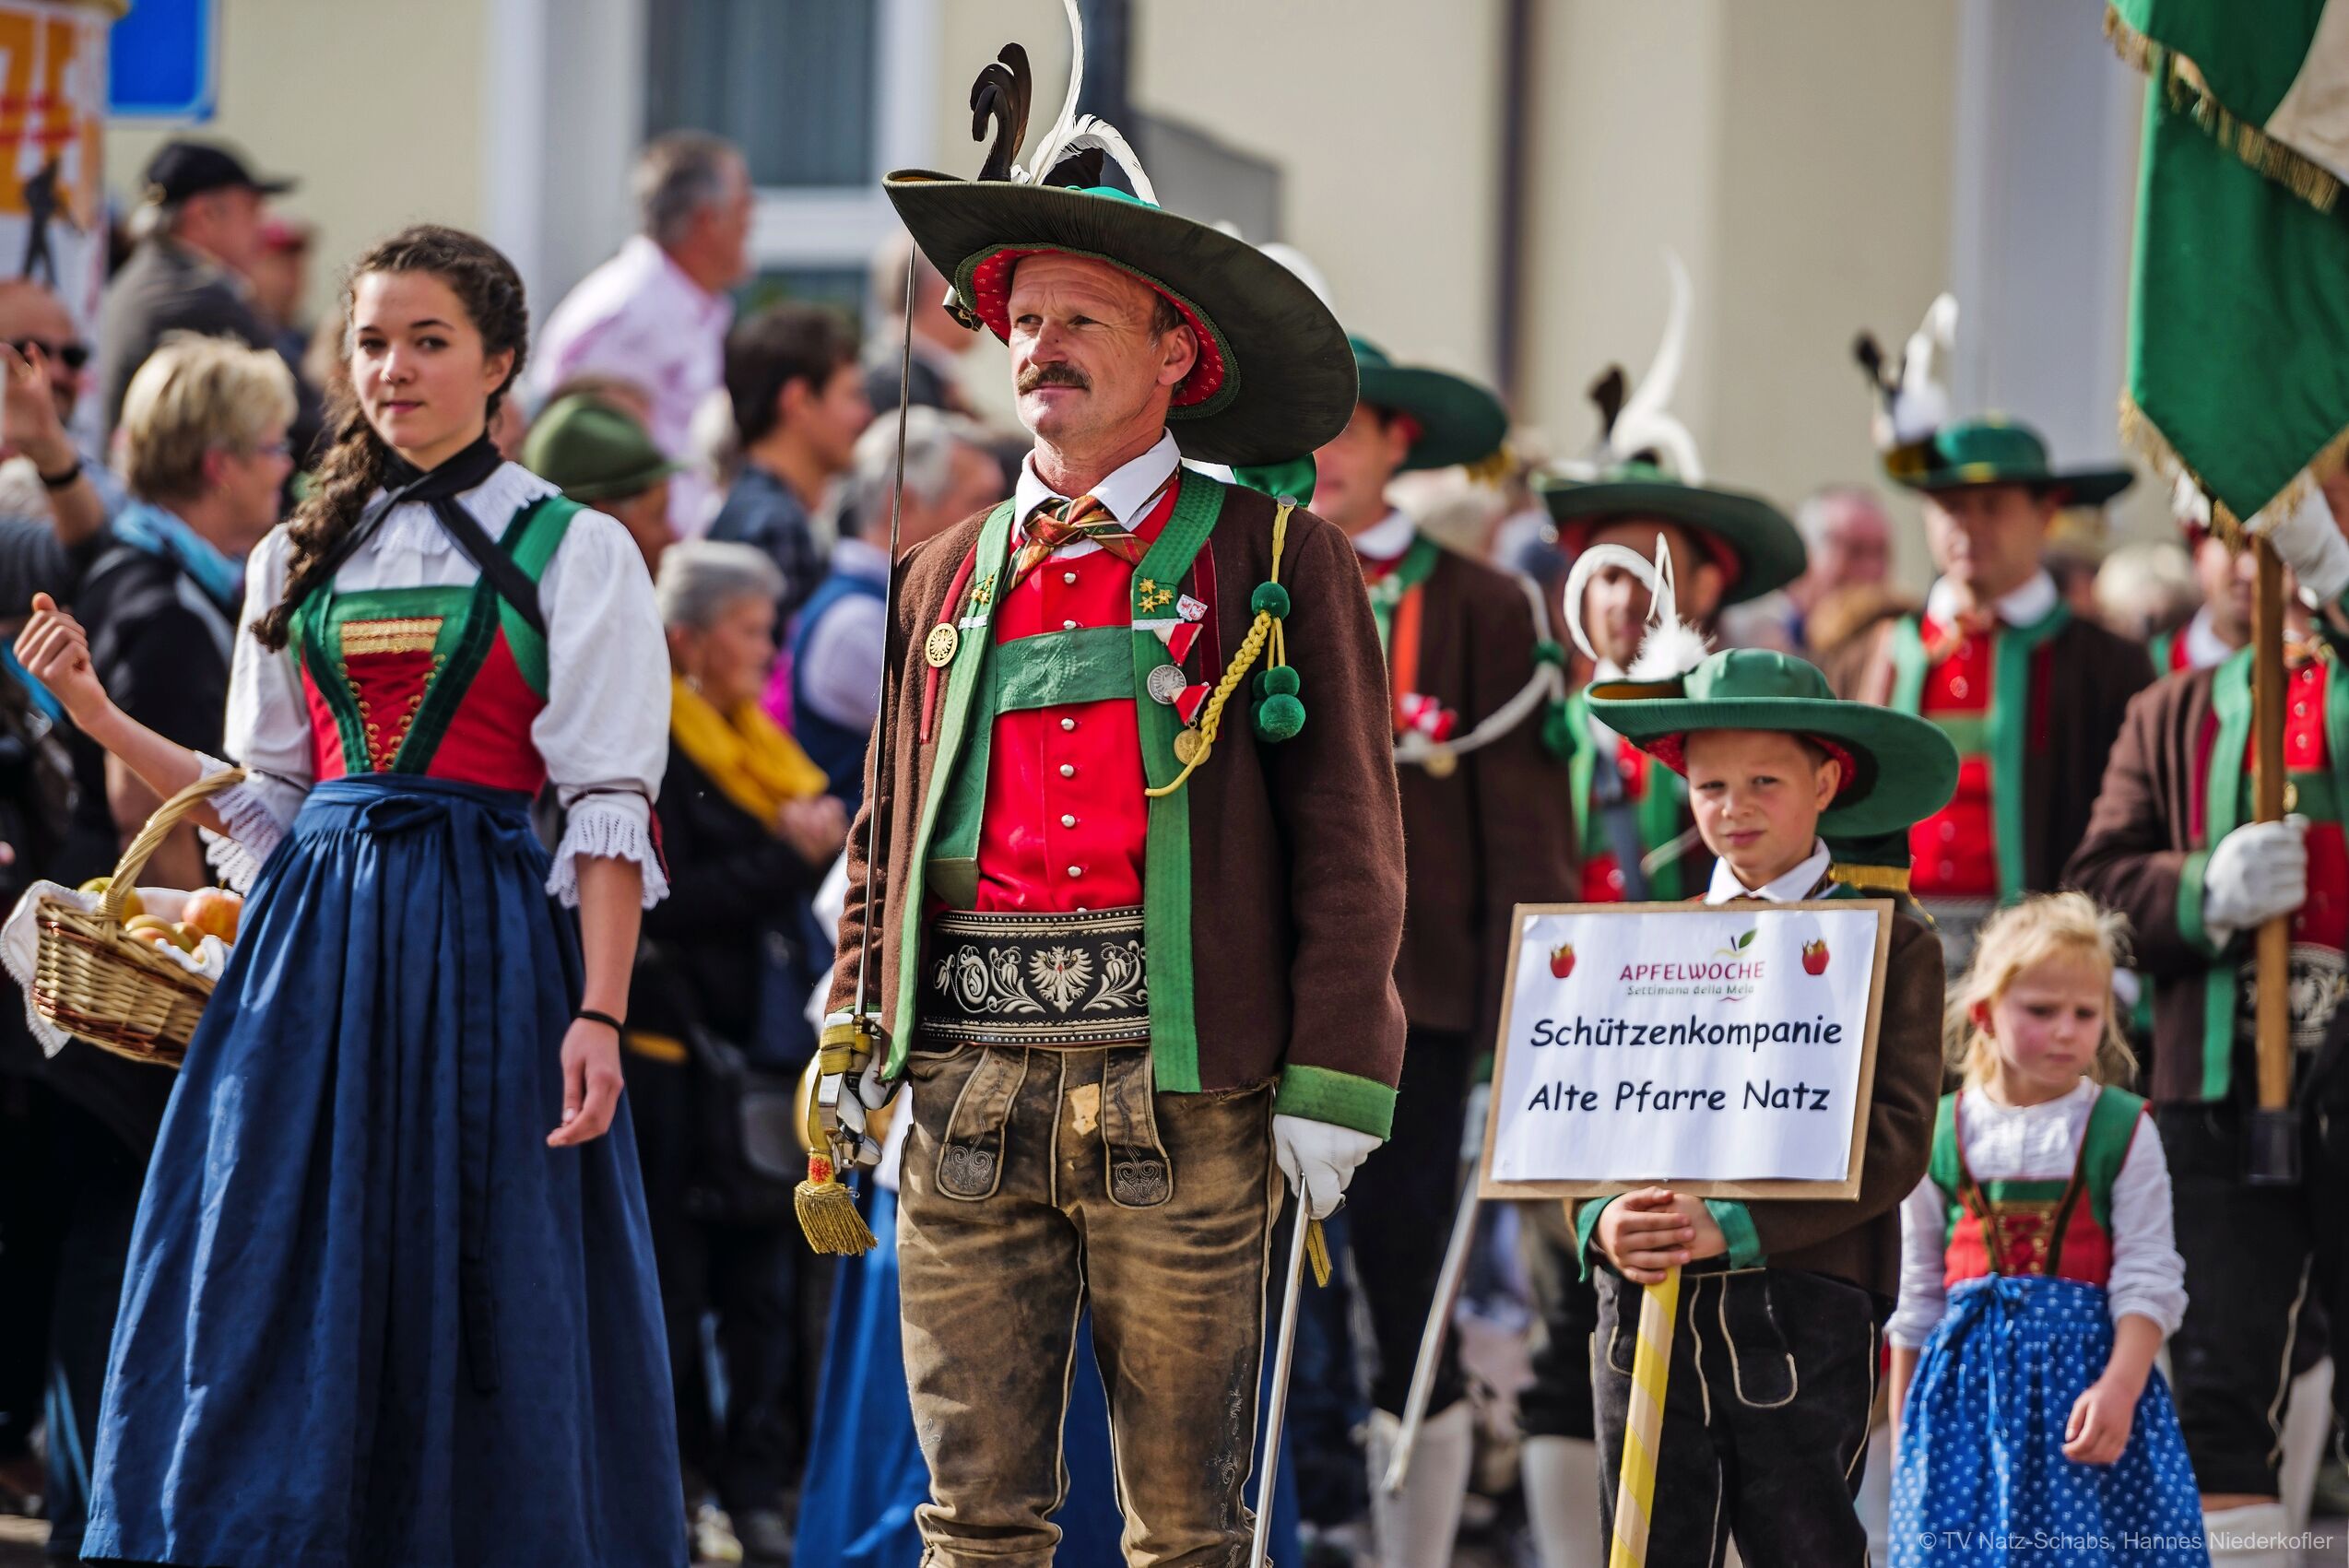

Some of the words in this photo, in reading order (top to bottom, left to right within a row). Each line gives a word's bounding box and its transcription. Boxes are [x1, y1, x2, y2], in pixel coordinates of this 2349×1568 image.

[1619, 961, 1765, 981] APFELWOCHE
[1627, 985, 1689, 996] Settimana
[1693, 984, 1722, 995] della
[1727, 984, 1754, 995] Mela
[1530, 1015, 1842, 1052] Schützenkompanie
[1528, 1080, 1598, 1111] Alte
[1615, 1080, 1726, 1113] Pfarre
[1743, 1079, 1831, 1111] Natz
